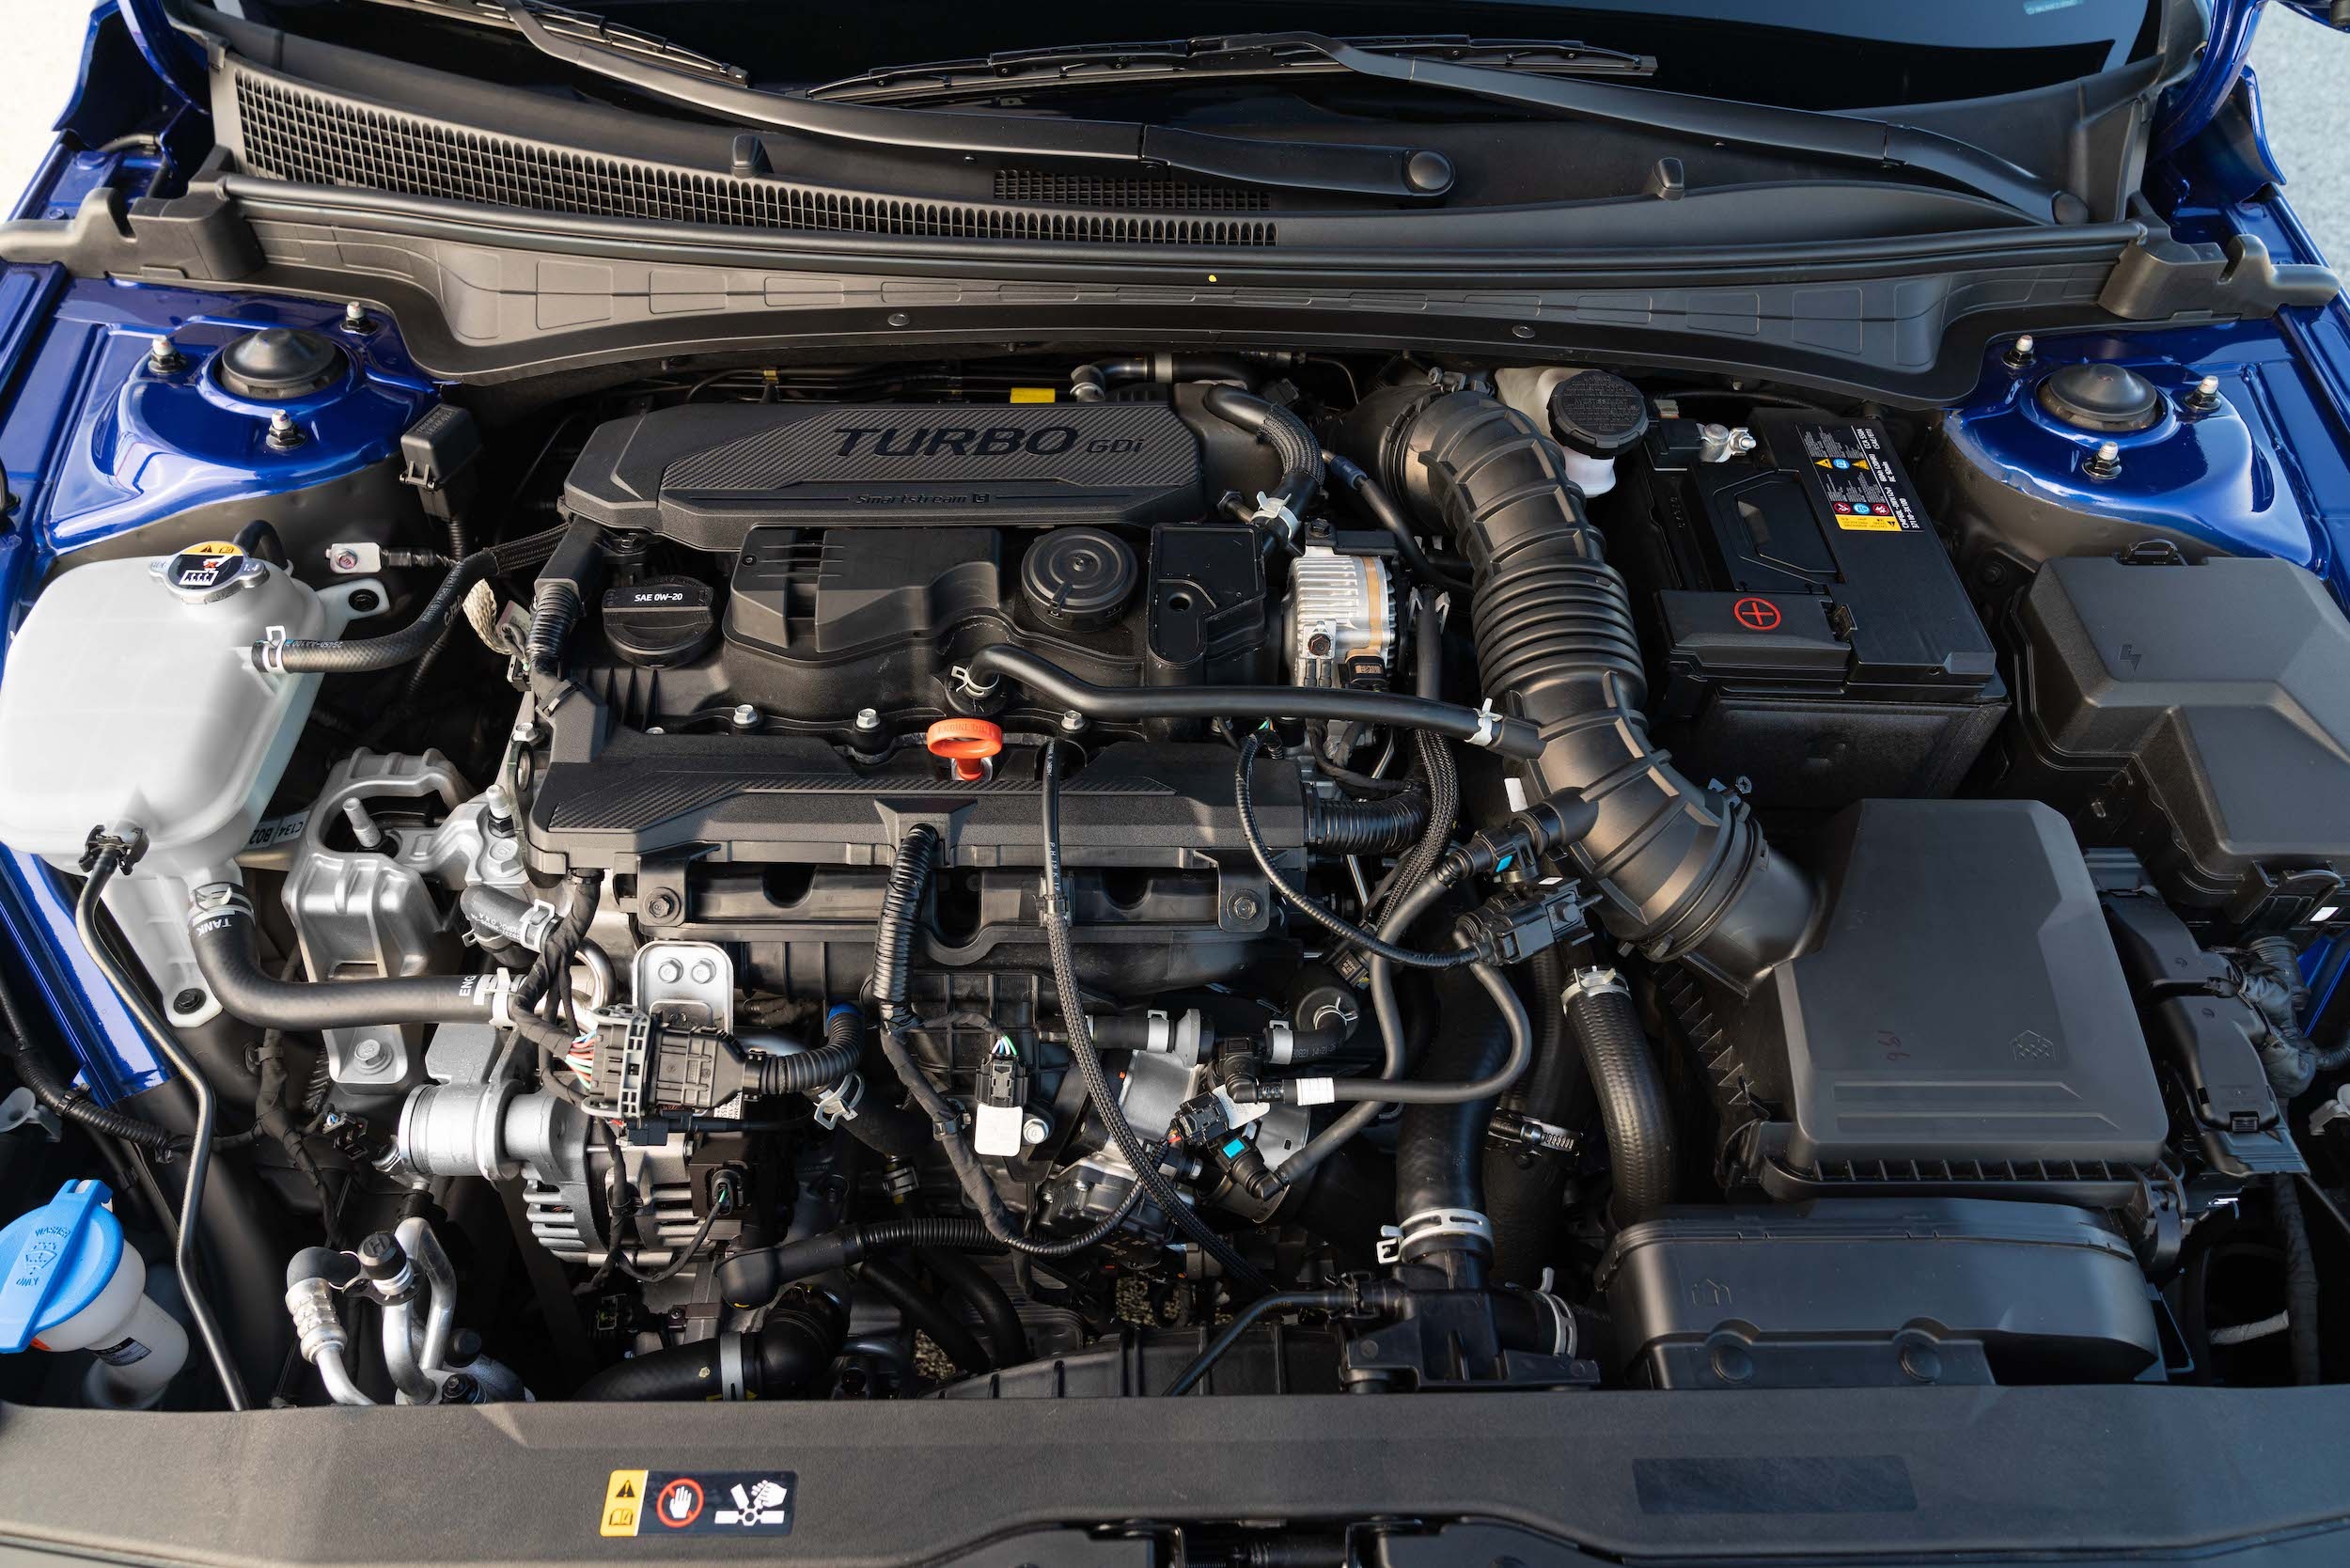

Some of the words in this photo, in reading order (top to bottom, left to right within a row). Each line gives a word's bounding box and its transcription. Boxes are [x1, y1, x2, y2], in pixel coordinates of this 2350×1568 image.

[834, 426, 1079, 458] TURBO
[1086, 438, 1144, 454] GDi
[855, 494, 967, 504] Smartstream
[634, 593, 653, 603] SAE
[653, 592, 683, 602] 0W-20
[249, 827, 274, 845] B02
[277, 821, 304, 838] C134
[196, 917, 232, 937] TANK
[458, 975, 478, 996] ENG
[35, 1226, 70, 1239] WASHER
[16, 1277, 39, 1287] ONLY
